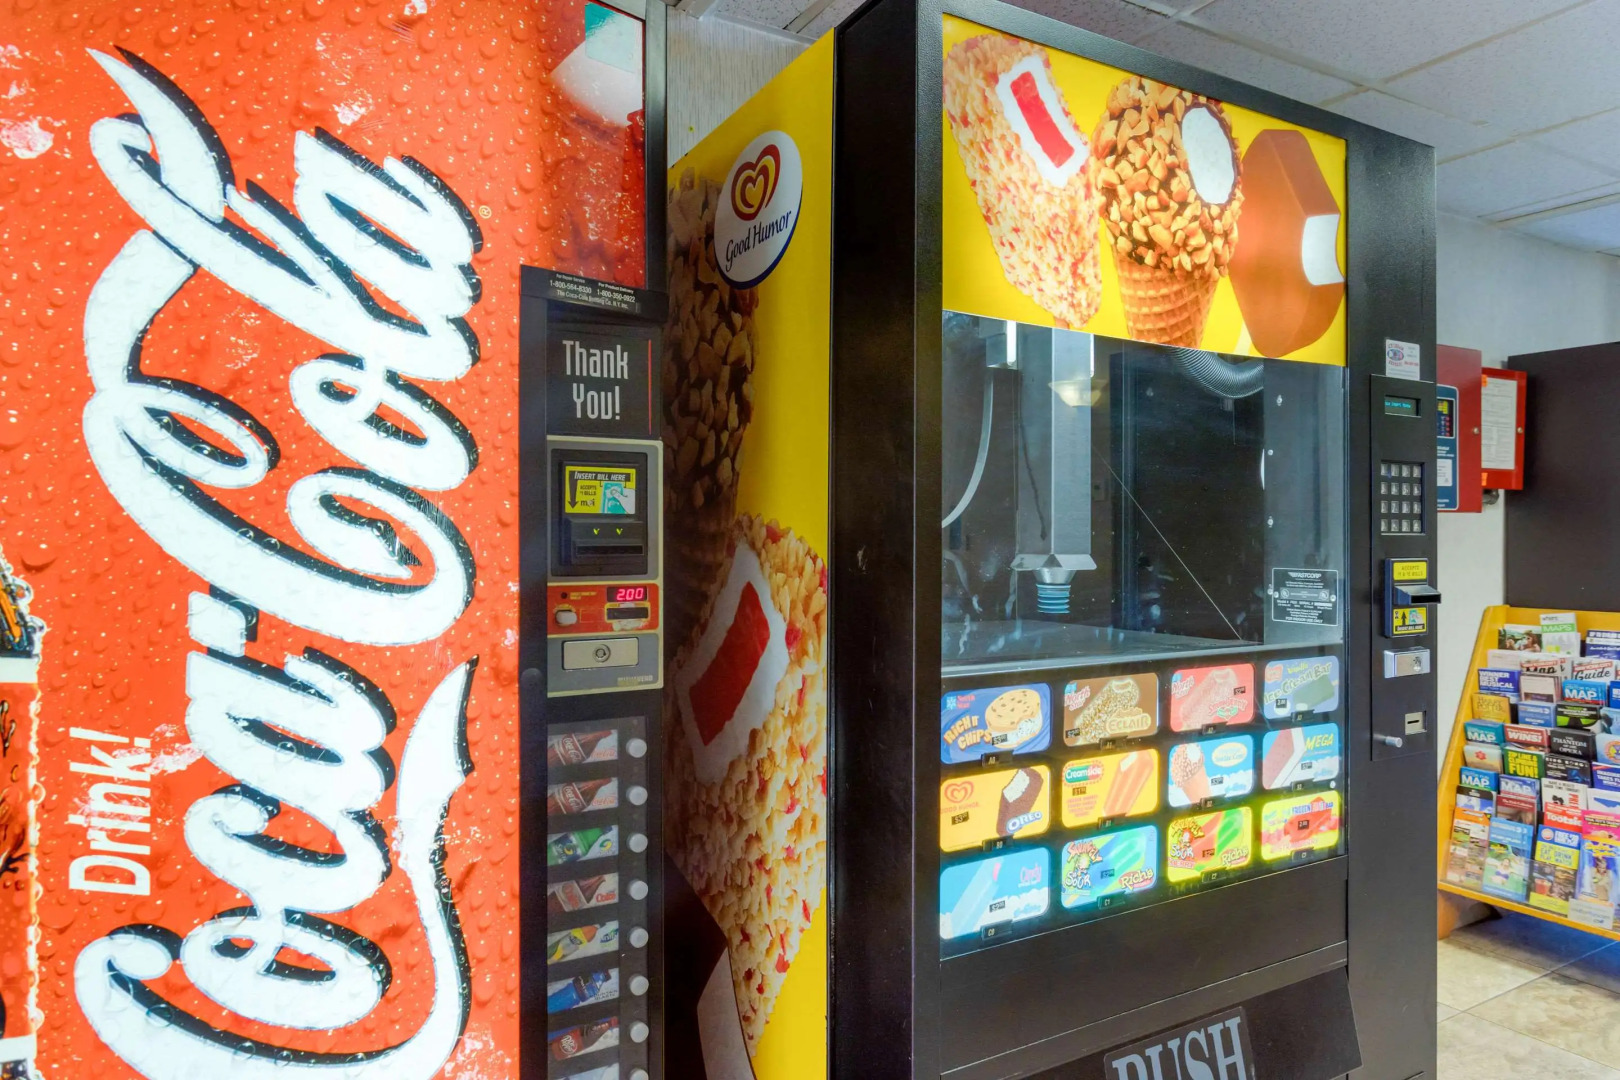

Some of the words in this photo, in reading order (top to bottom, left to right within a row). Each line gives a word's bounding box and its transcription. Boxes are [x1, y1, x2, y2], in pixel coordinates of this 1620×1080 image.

[726, 226, 751, 273] Good
[752, 210, 792, 249] Humor
[562, 339, 629, 380] Thank
[572, 382, 621, 421] You!
[574, 471, 596, 480] INSERT
[596, 472, 609, 481] BILL
[74, 45, 484, 1080] Coca-Cola
[1543, 624, 1572, 632] MAPS
[1574, 667, 1611, 681] Guide
[1264, 689, 1282, 704] Ice
[1282, 670, 1313, 695] Cream
[1313, 661, 1332, 680] Bar
[1064, 685, 1091, 707] North
[1565, 688, 1597, 700] MAP
[1109, 715, 1149, 731] ECLAIR
[1305, 733, 1334, 751] MEGA
[1466, 730, 1497, 743] MAP
[1508, 730, 1543, 743] WINS!
[1065, 765, 1103, 780] Creamsicle
[1508, 763, 1539, 779] FUN!
[1461, 774, 1490, 788] MAP
[1500, 779, 1532, 794] MAP
[69, 728, 152, 895] Drink!
[1292, 804, 1312, 815] FROZEN
[1007, 811, 1042, 832] OREO
[595, 891, 617, 903] Coke
